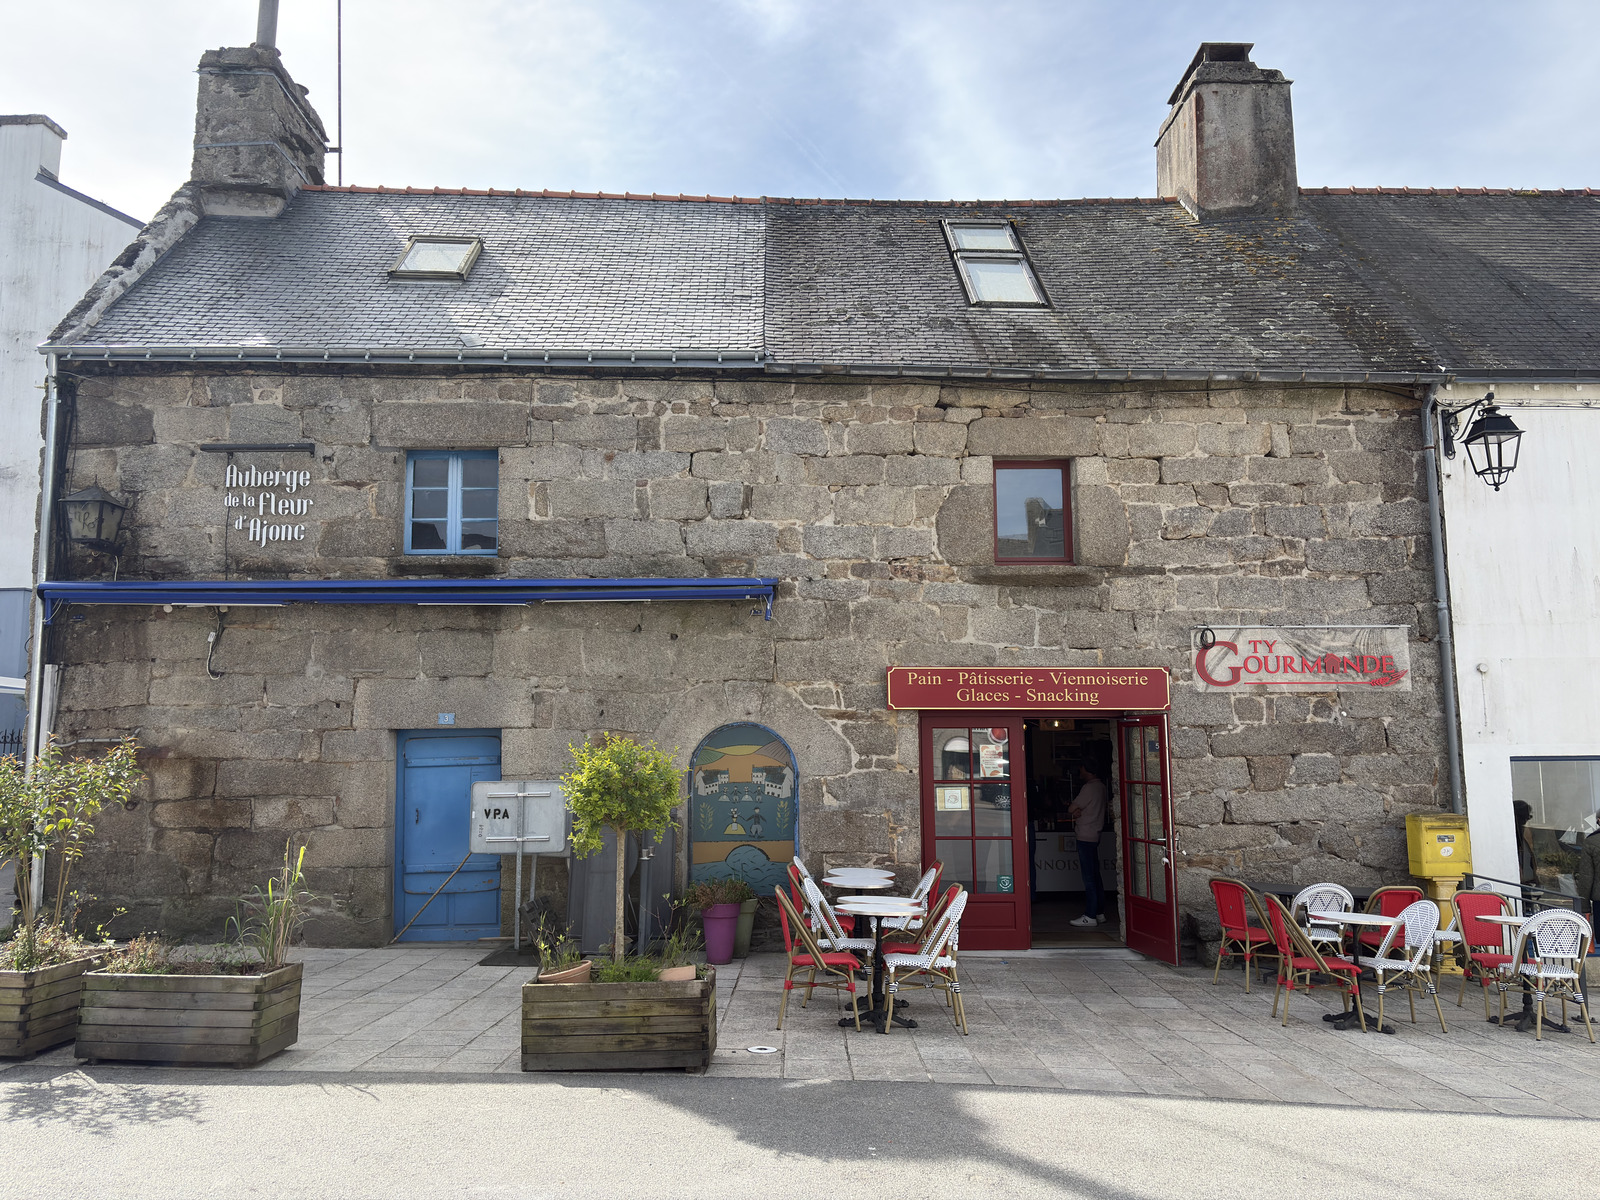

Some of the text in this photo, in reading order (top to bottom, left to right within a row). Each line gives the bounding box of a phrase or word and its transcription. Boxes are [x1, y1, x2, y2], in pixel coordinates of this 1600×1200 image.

[225, 464, 310, 493] Auberge
[224, 492, 239, 507] de
[242, 492, 255, 507] la
[1248, 640, 1278, 653] TY
[907, 671, 942, 685] Pain
[958, 671, 1034, 685] Pâtisserie
[1049, 671, 1149, 685] Viennoiserie
[956, 688, 1010, 702] Glaces
[1026, 688, 1100, 706] Snacking
[444, 715, 449, 723] 3
